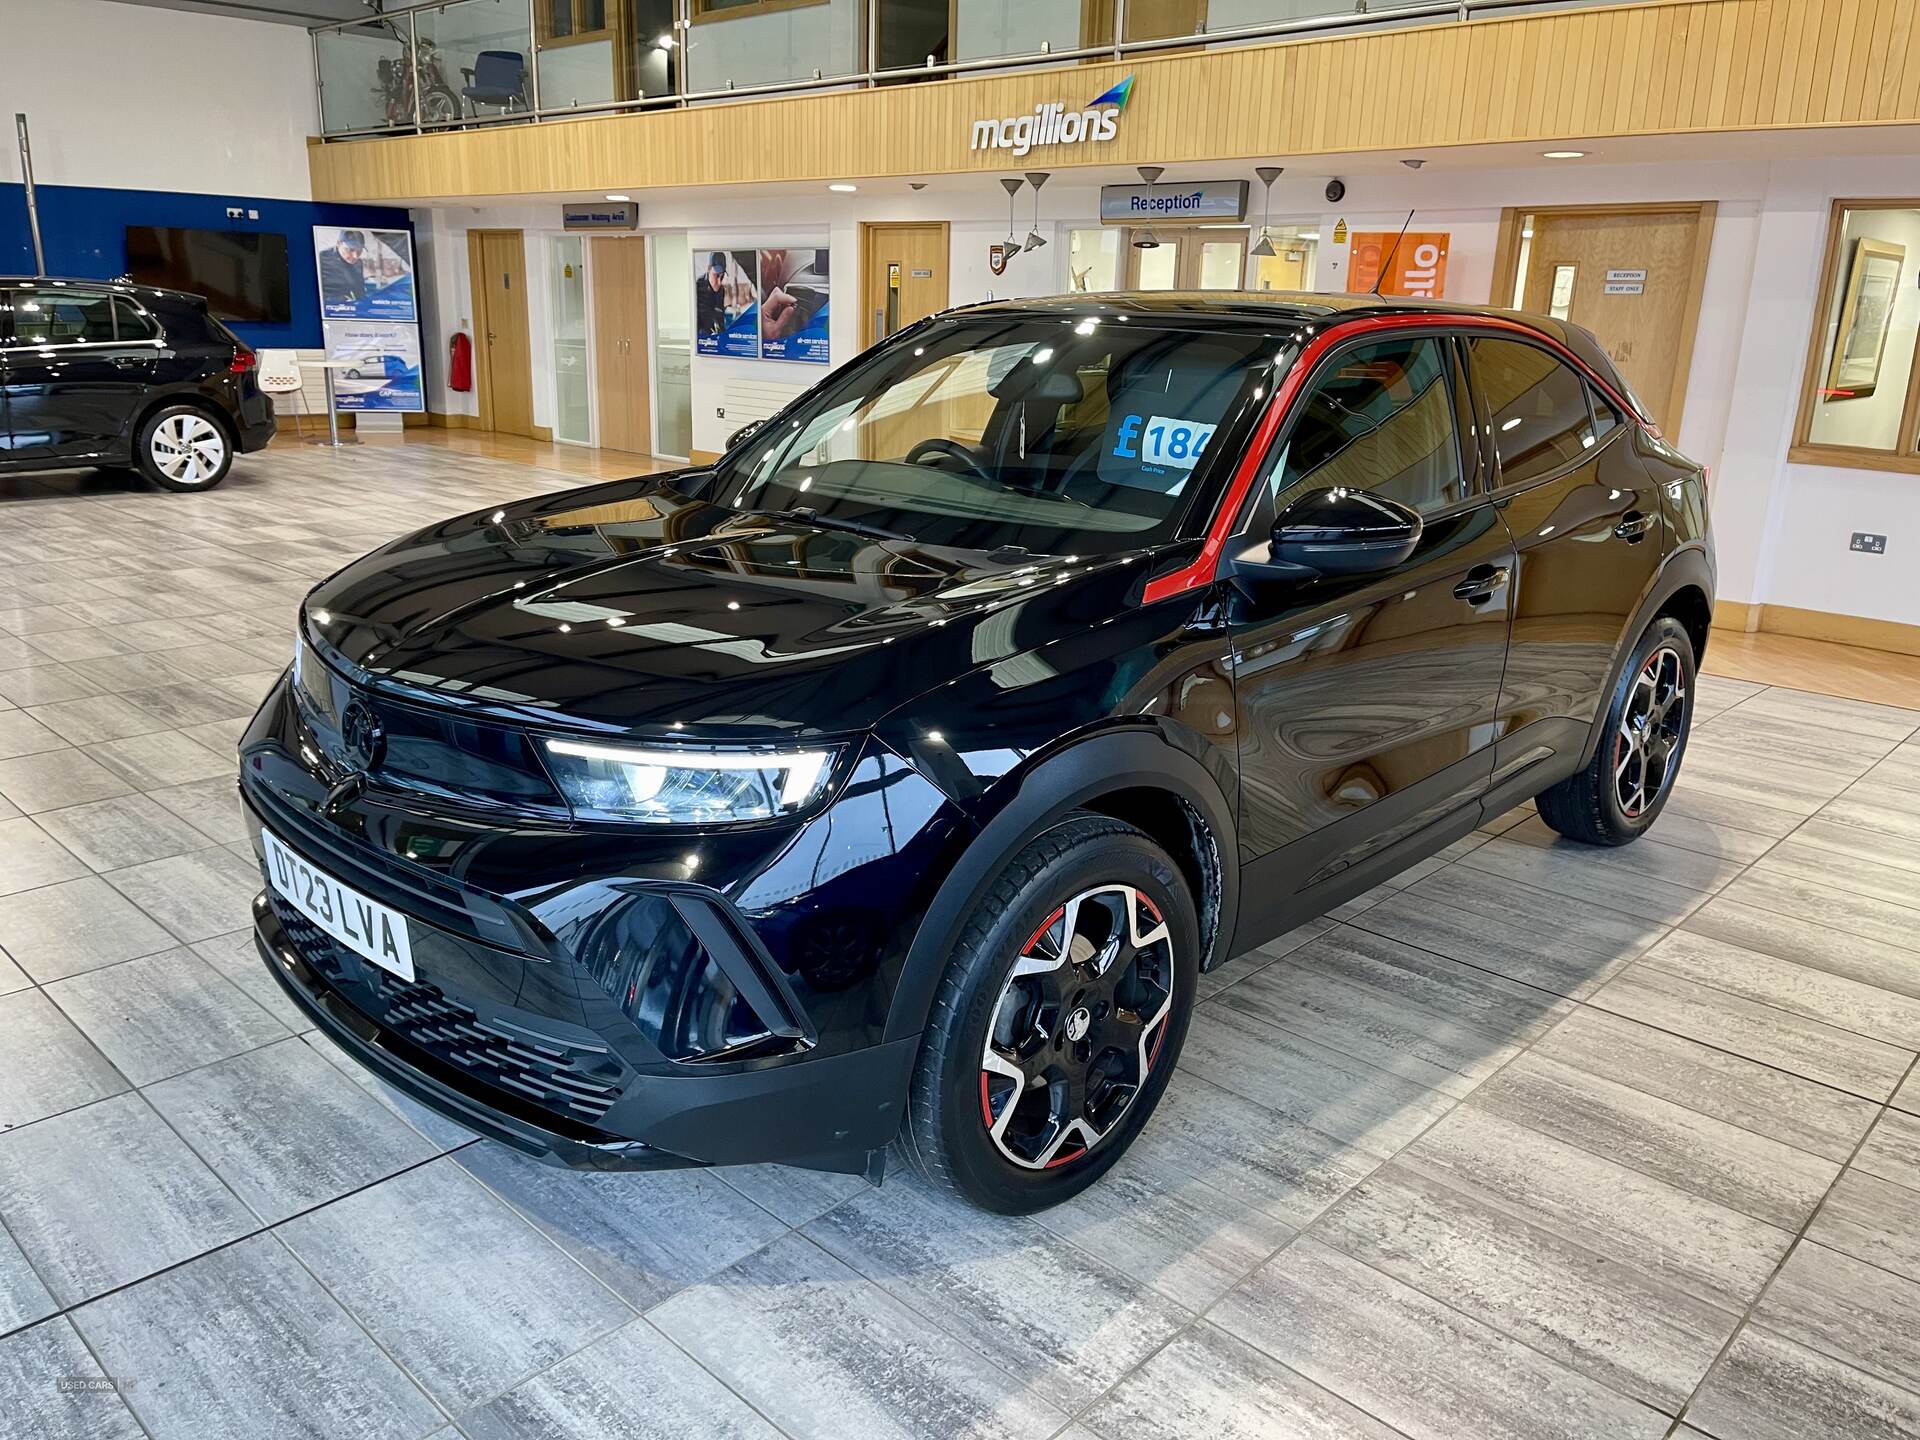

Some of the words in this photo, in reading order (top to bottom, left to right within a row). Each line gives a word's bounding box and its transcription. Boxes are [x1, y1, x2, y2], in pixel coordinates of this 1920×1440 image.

[971, 102, 1119, 156] mcgillions
[1131, 194, 1201, 213] Reception
[1141, 465, 1153, 473] Cash
